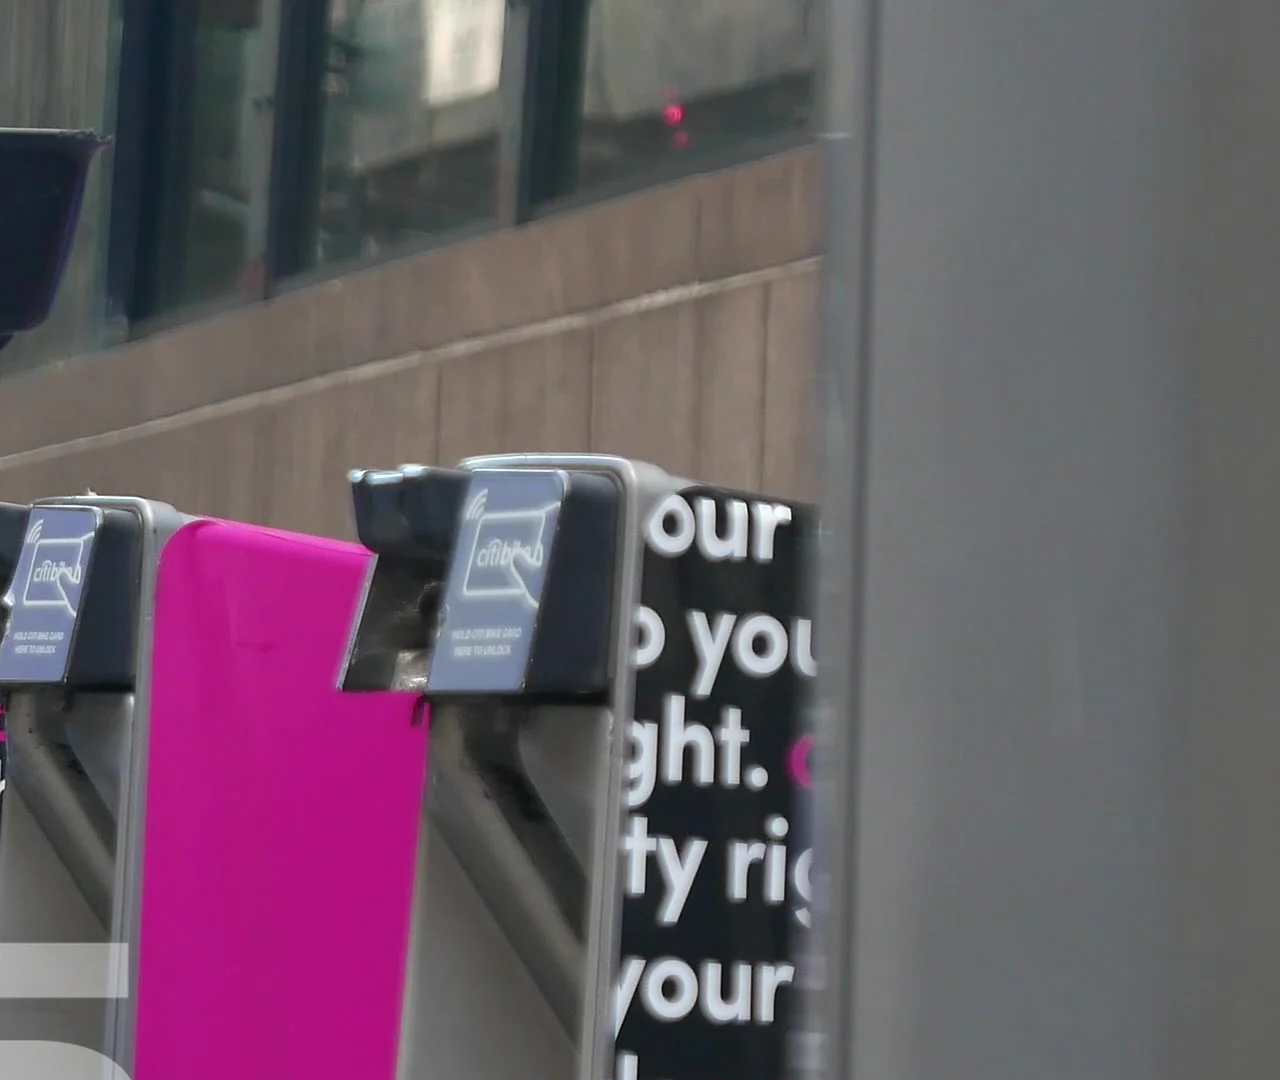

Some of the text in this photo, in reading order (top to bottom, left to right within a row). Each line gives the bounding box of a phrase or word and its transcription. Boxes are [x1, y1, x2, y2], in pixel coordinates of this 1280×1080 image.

[645, 493, 793, 561] our
[621, 815, 709, 926] ty
[613, 956, 795, 1042] your
